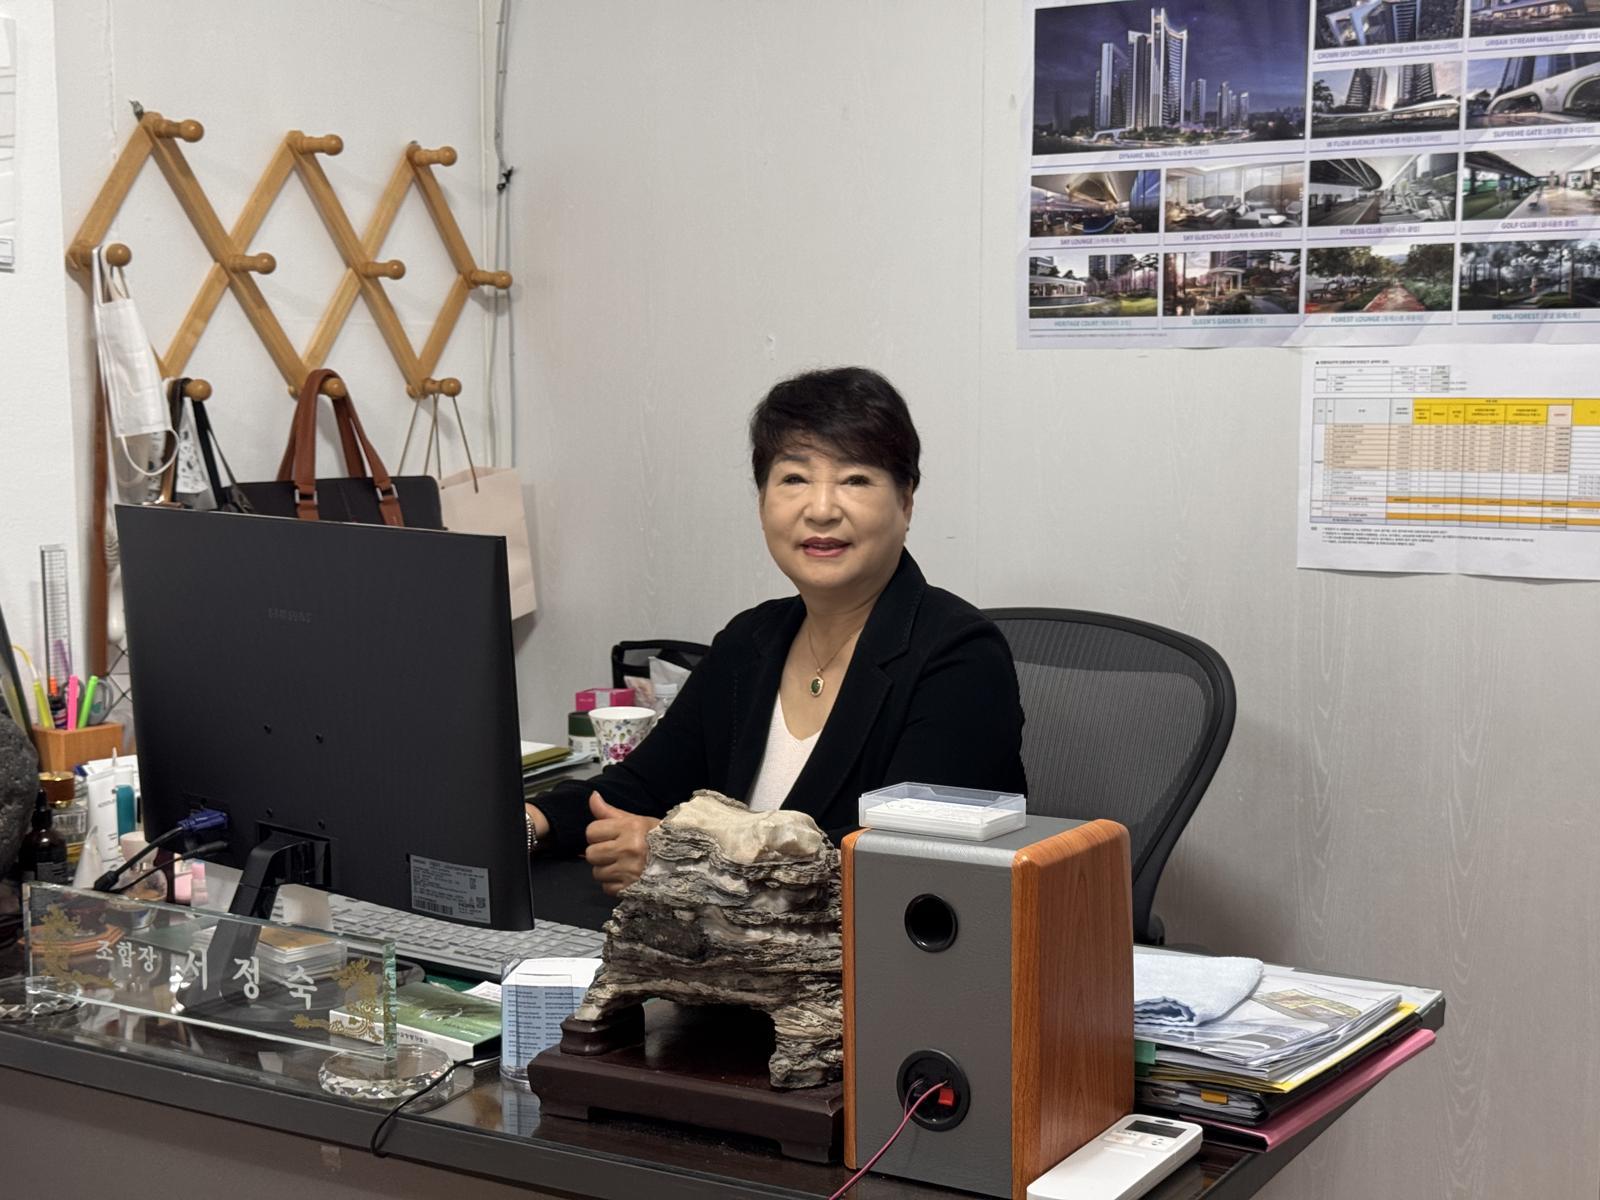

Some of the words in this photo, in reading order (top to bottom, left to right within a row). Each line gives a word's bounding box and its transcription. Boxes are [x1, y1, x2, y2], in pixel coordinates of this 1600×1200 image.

[95, 940, 158, 973] 조합장
[181, 950, 209, 991] 서
[232, 956, 260, 999] 정
